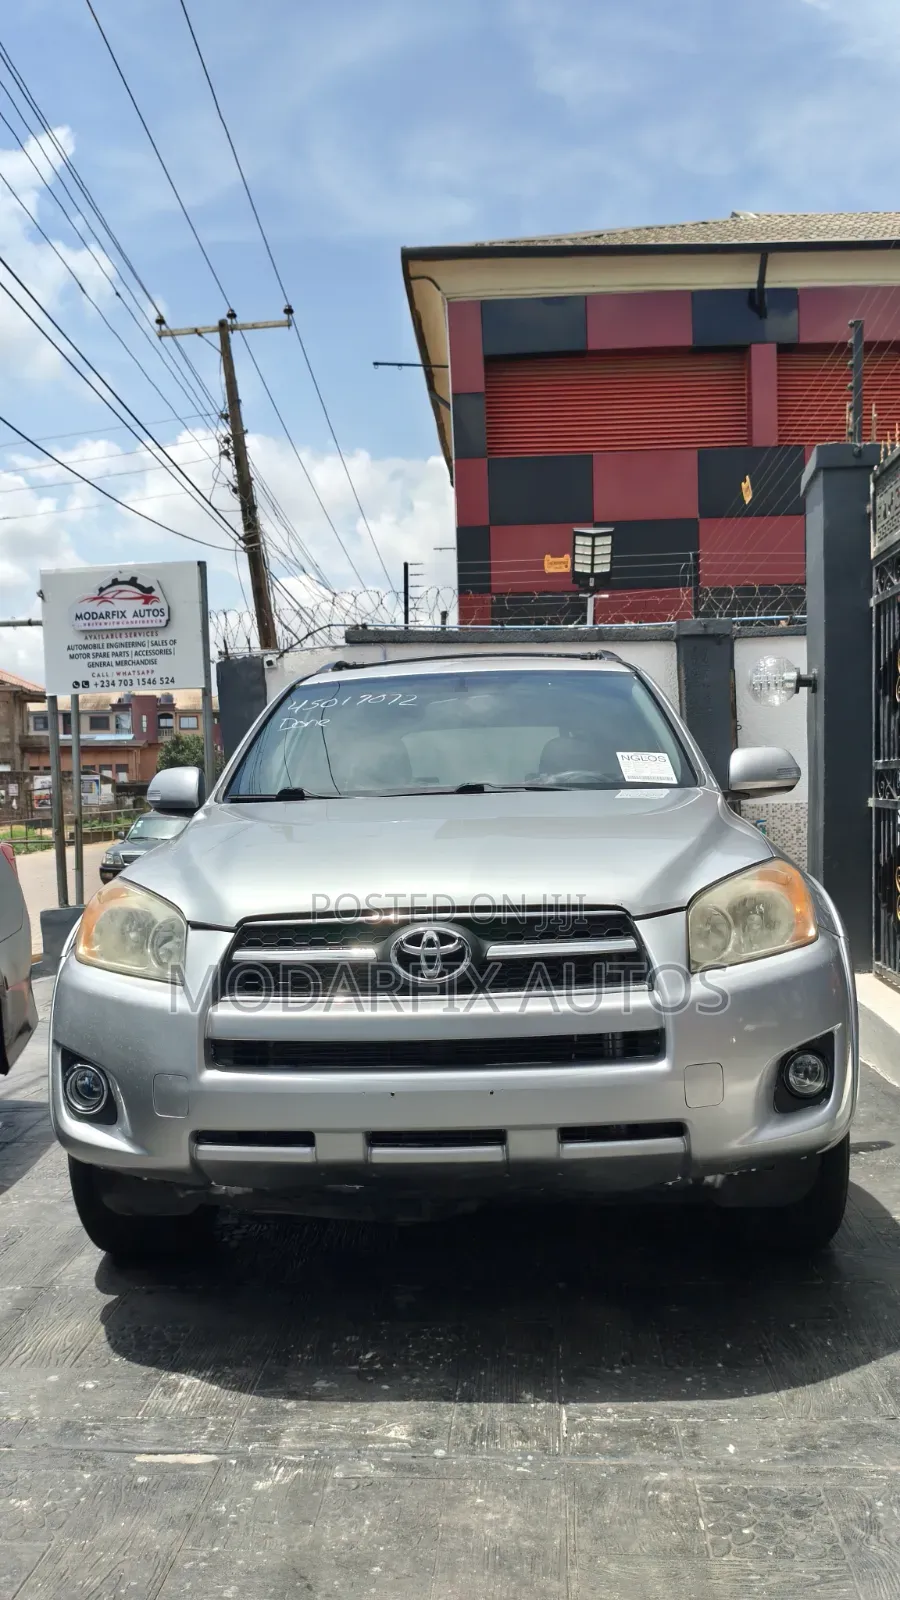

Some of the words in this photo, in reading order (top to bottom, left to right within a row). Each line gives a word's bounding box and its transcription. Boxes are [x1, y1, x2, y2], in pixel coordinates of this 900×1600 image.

[75, 609, 127, 621] MODARFIX
[132, 607, 165, 619] AUTOS
[84, 632, 122, 640] AVAILABLE
[124, 630, 159, 638] SERVICES
[66, 642, 105, 651] AUTOMOBILE
[106, 641, 146, 649] ENGINEERING
[150, 639, 168, 647] SALES
[69, 652, 90, 660] MOTOR
[91, 651, 110, 659] SPARE
[111, 650, 130, 658] PARTS
[134, 648, 172, 657] ACCESSORIES
[87, 660, 114, 669] GENERAL
[115, 658, 158, 667] MERCHANDISE
[115, 669, 155, 677] WHATSAPP
[93, 679, 116, 688] +234
[118, 679, 134, 687] 703
[137, 677, 157, 686] 1546
[159, 676, 175, 685] 524
